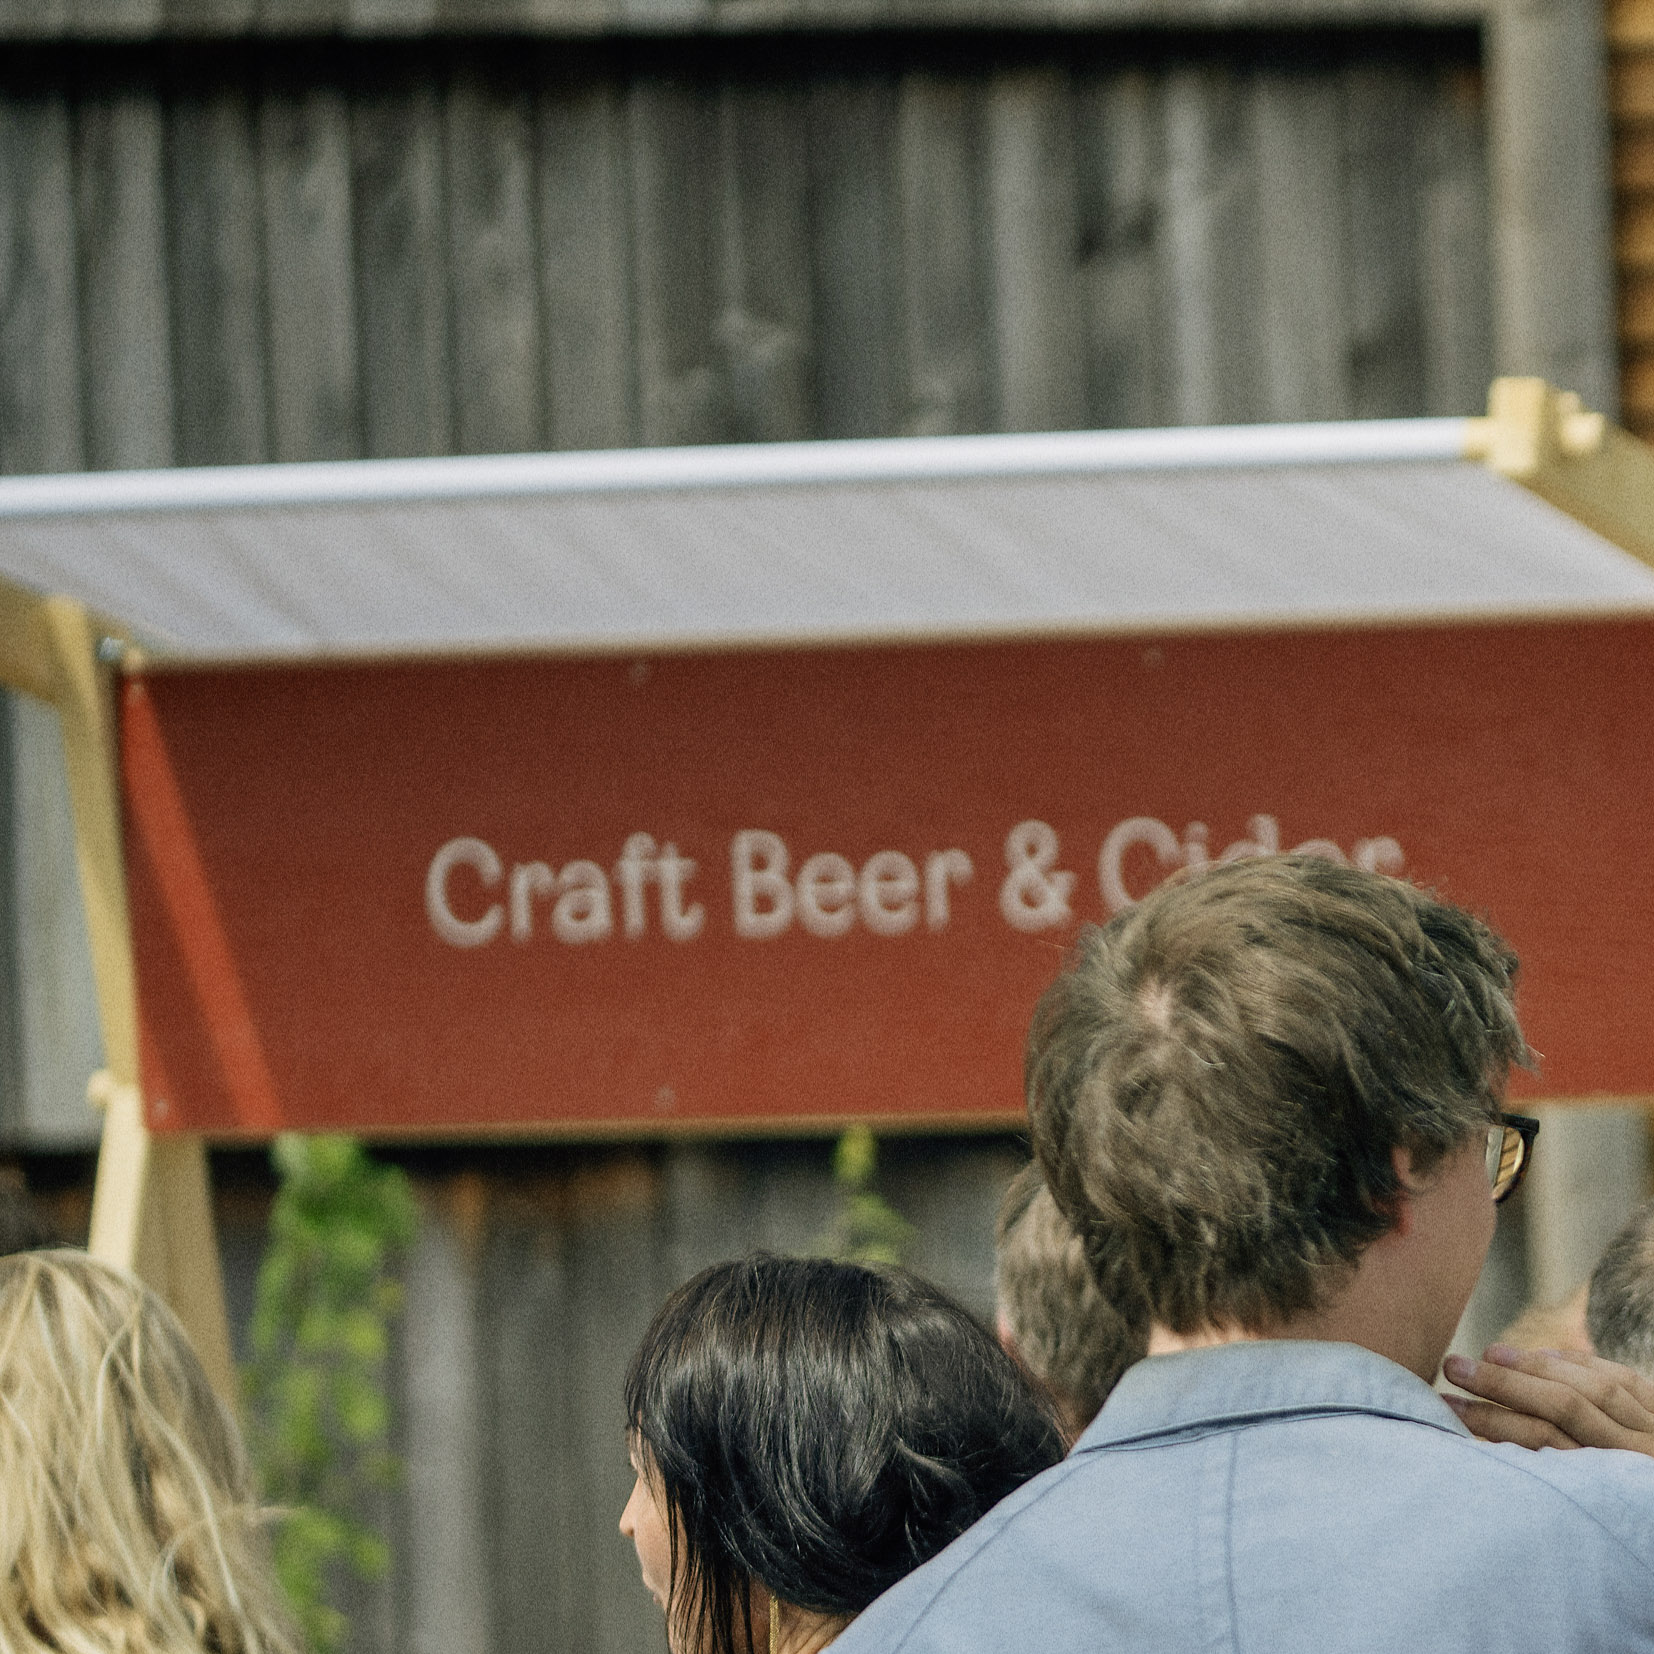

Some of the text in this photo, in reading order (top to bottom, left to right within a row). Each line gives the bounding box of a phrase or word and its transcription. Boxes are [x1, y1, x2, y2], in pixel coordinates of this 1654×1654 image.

[425, 831, 705, 948] Craft
[729, 828, 973, 940] Beer
[999, 818, 1076, 933] &
